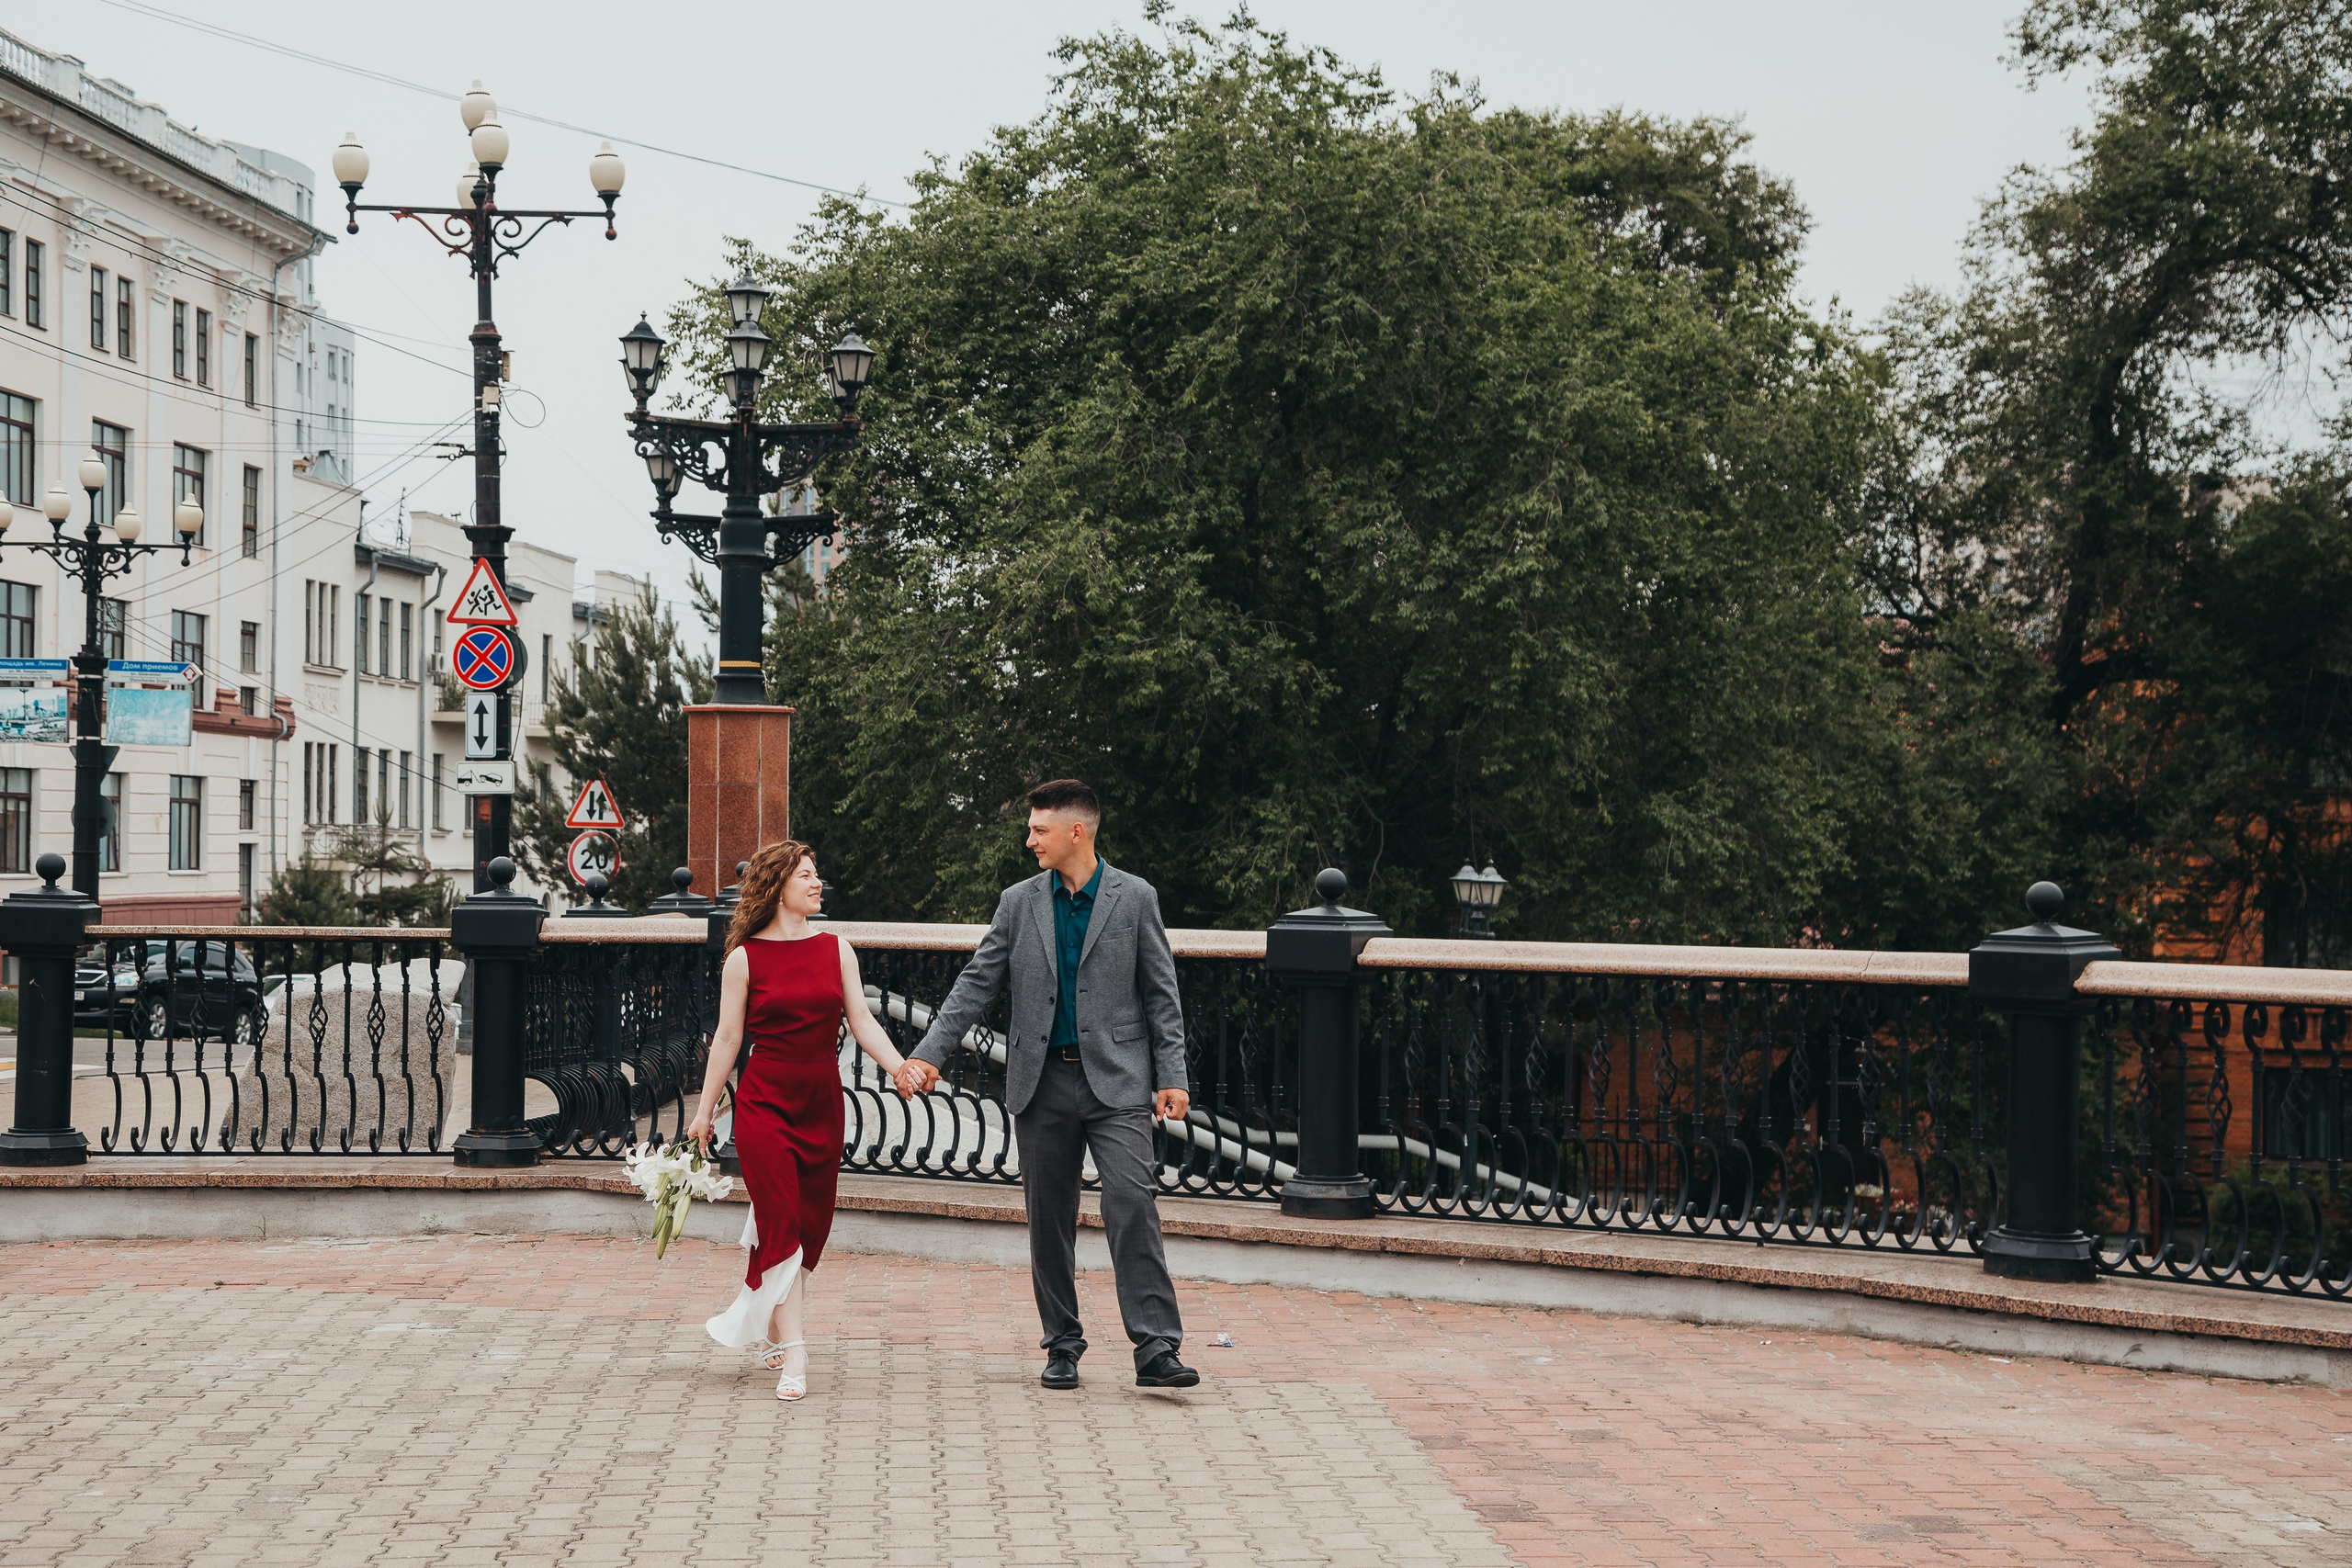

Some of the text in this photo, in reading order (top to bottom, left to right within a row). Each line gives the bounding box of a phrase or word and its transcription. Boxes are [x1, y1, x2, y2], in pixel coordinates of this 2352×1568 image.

[122, 661, 178, 671] Дом приемов
[581, 849, 608, 870] 20
